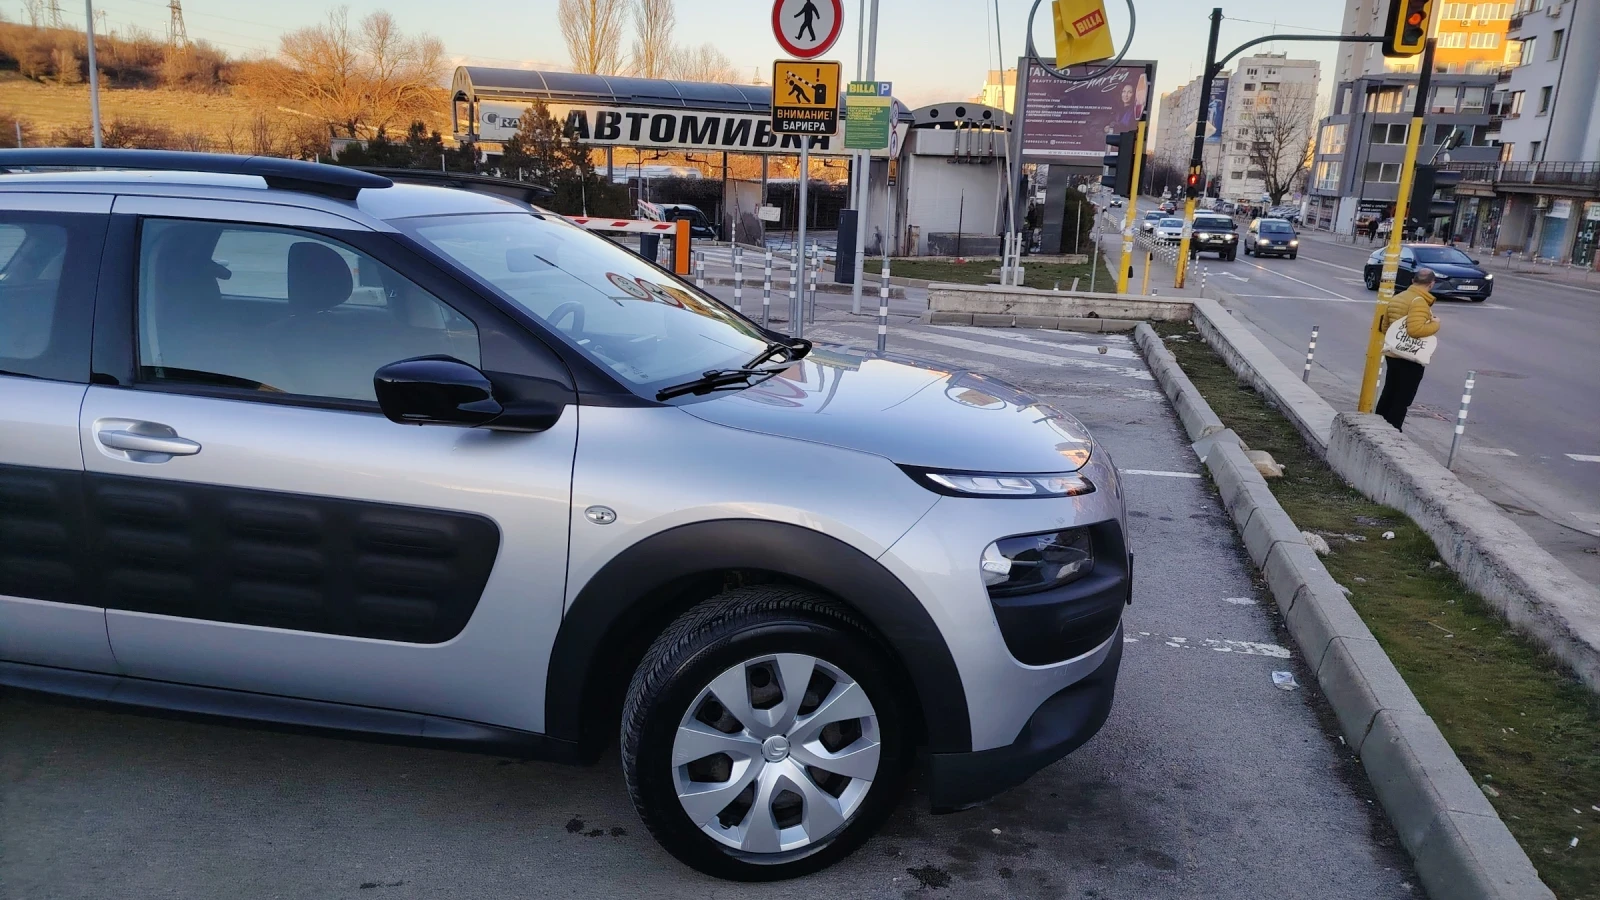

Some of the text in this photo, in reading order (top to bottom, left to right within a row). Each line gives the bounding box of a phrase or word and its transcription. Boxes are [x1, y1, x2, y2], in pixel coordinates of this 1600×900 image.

[1075, 13, 1103, 34] BILLA
[1029, 67, 1071, 77] TATO
[849, 83, 890, 95] BILLA P
[777, 109, 833, 120] ВНИМАНИЕ!
[782, 120, 826, 132] БАРИЕРА
